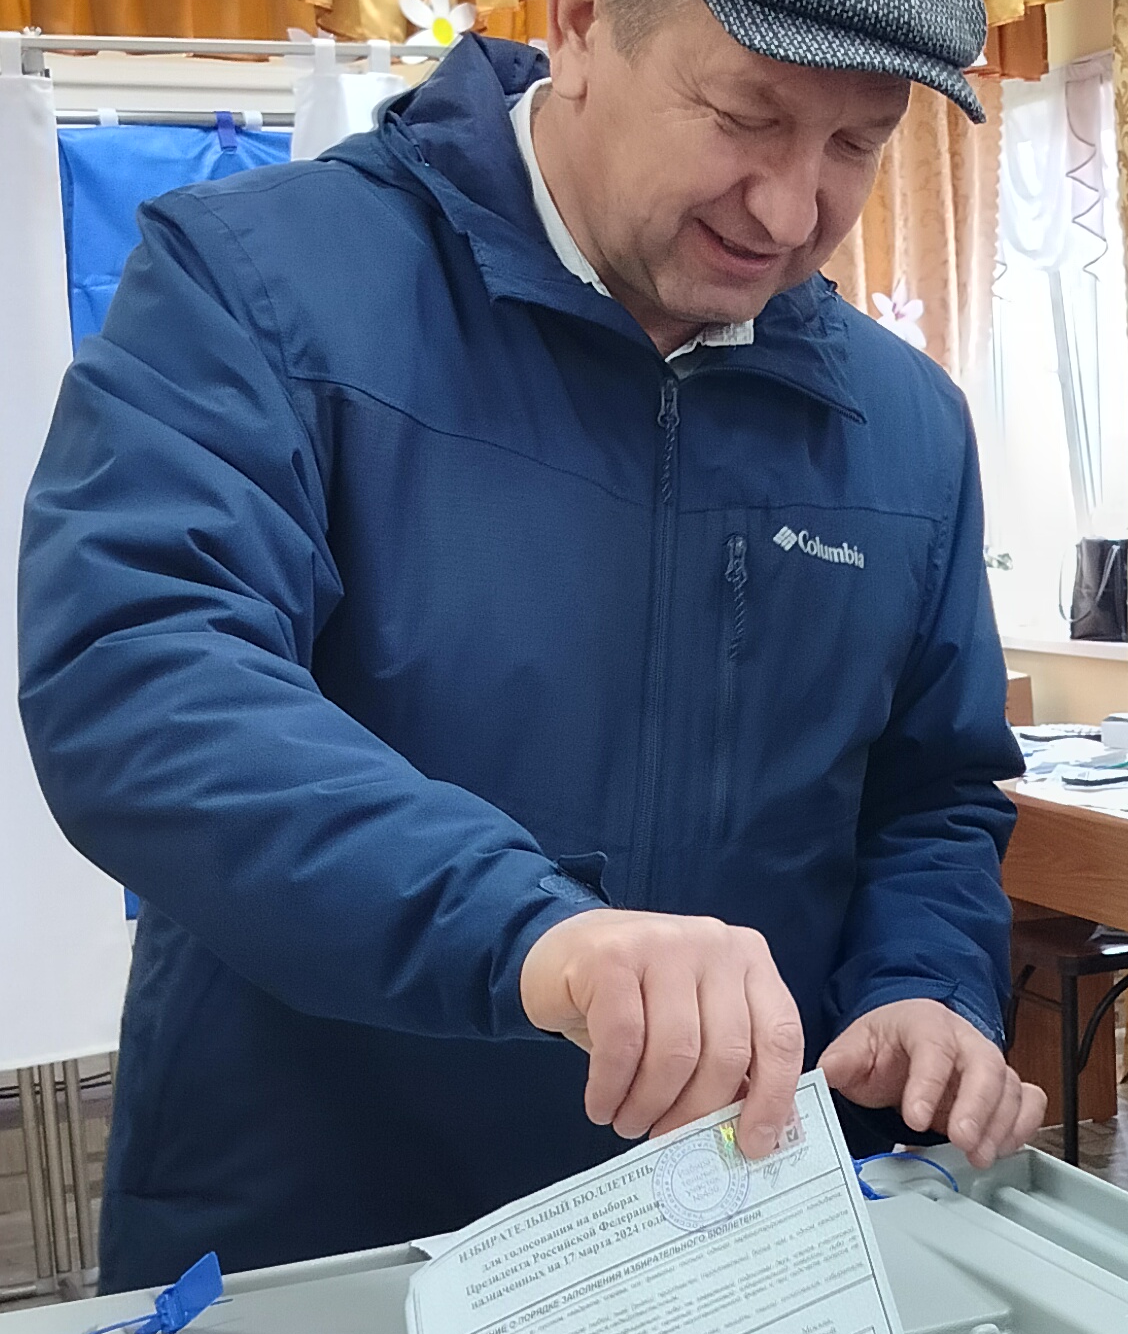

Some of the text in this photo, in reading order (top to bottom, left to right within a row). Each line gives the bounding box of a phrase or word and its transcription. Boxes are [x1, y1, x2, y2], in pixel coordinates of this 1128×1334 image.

[798, 530, 865, 569] Columbia
[453, 1200, 572, 1263] ИЗБИРАТЕЛЬНЫЙ
[573, 1165, 655, 1207] БЮЛЛЕТЕНЬ
[466, 1260, 530, 1296] Президента
[532, 1226, 596, 1264] Российской
[599, 1194, 666, 1231] Федерации,
[471, 1212, 669, 1310] назначенных на 17 марта 2024 года
[482, 1257, 502, 1273] для
[504, 1223, 573, 1261] голосования
[576, 1216, 589, 1227] на
[592, 1193, 639, 1219] выборах
[508, 1320, 518, 1331] О
[518, 1299, 559, 1325] ПОРЯДКЕ
[562, 1271, 622, 1304] ЗАПОЛНЕНИЯ
[624, 1232, 705, 1275] ИЗБИРАТЕЛЬНОГО
[707, 1207, 763, 1239] БЮЛЛЕТЕНЯ
